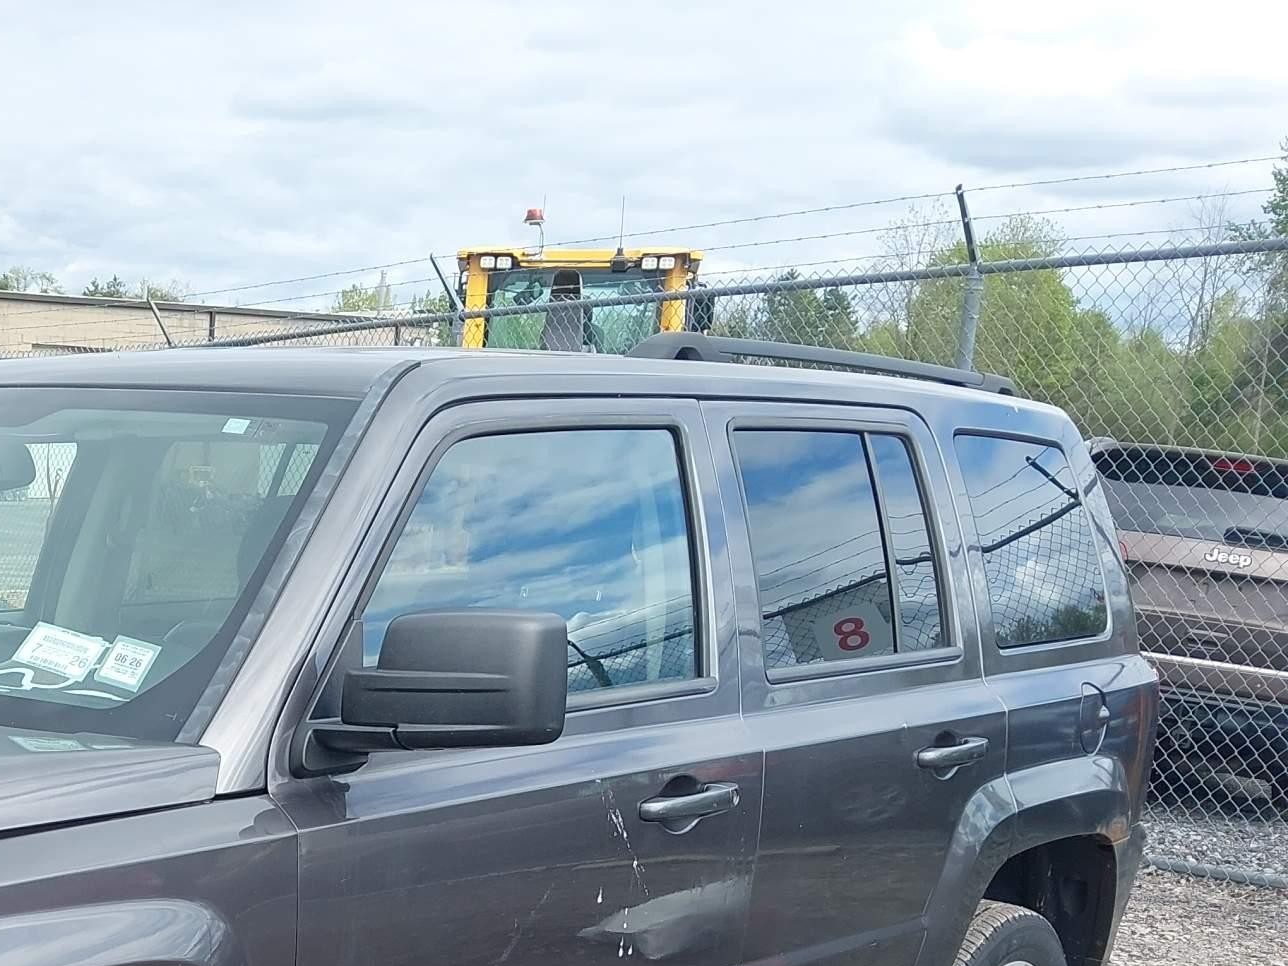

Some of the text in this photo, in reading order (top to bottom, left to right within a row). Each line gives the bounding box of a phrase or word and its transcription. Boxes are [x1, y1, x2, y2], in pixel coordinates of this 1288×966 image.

[1203, 547, 1253, 568] Jeep
[68, 655, 90, 669] 26
[114, 652, 143, 669] 06 26
